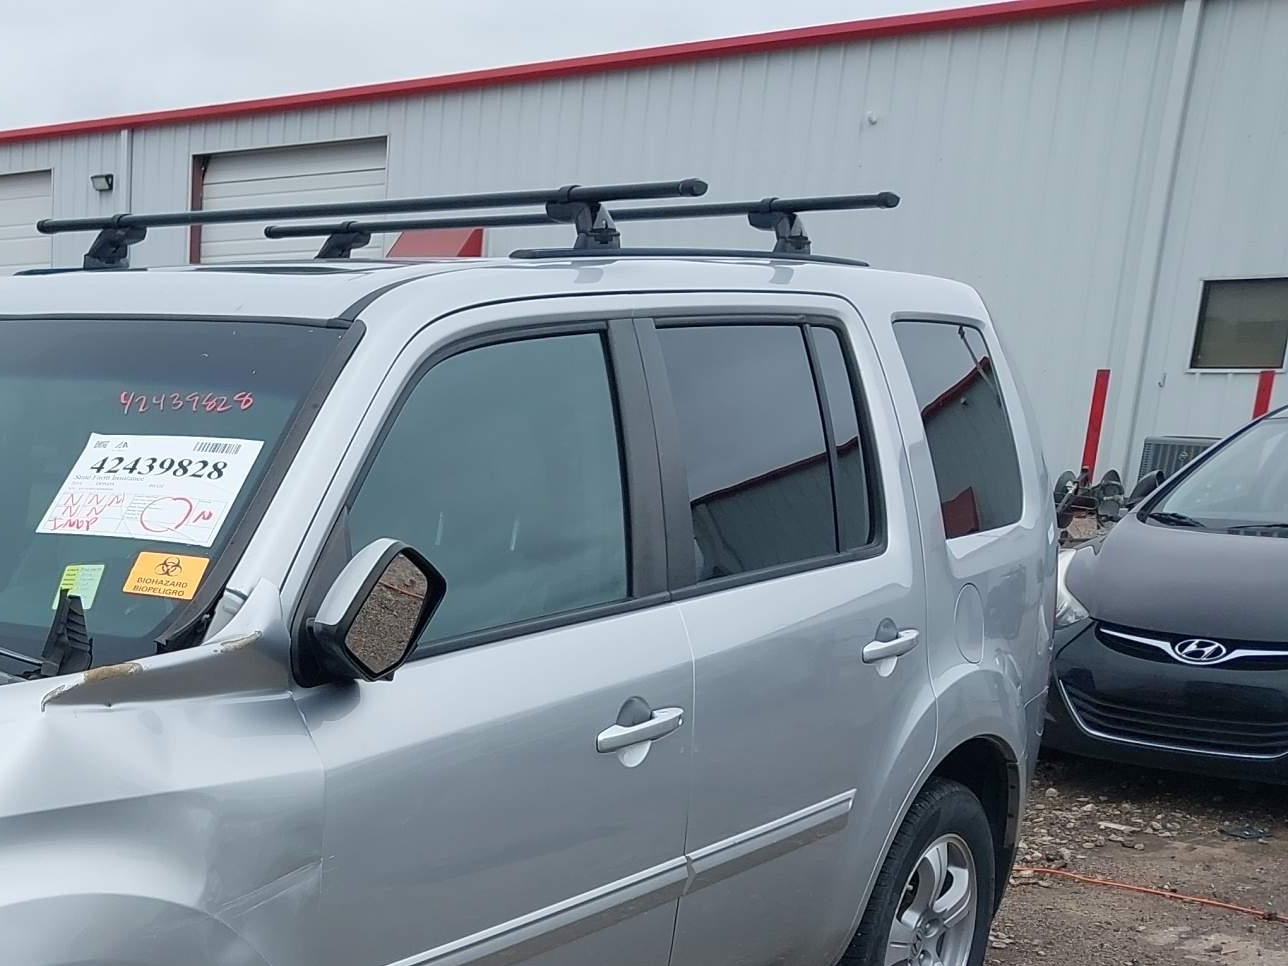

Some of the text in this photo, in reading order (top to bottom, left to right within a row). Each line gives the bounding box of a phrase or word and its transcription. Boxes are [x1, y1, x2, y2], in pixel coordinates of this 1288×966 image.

[120, 391, 255, 414] 42439828
[89, 456, 228, 480] 42439828
[132, 585, 185, 597] BIOPELIGRO
[136, 576, 188, 589] BIOHAZARD
